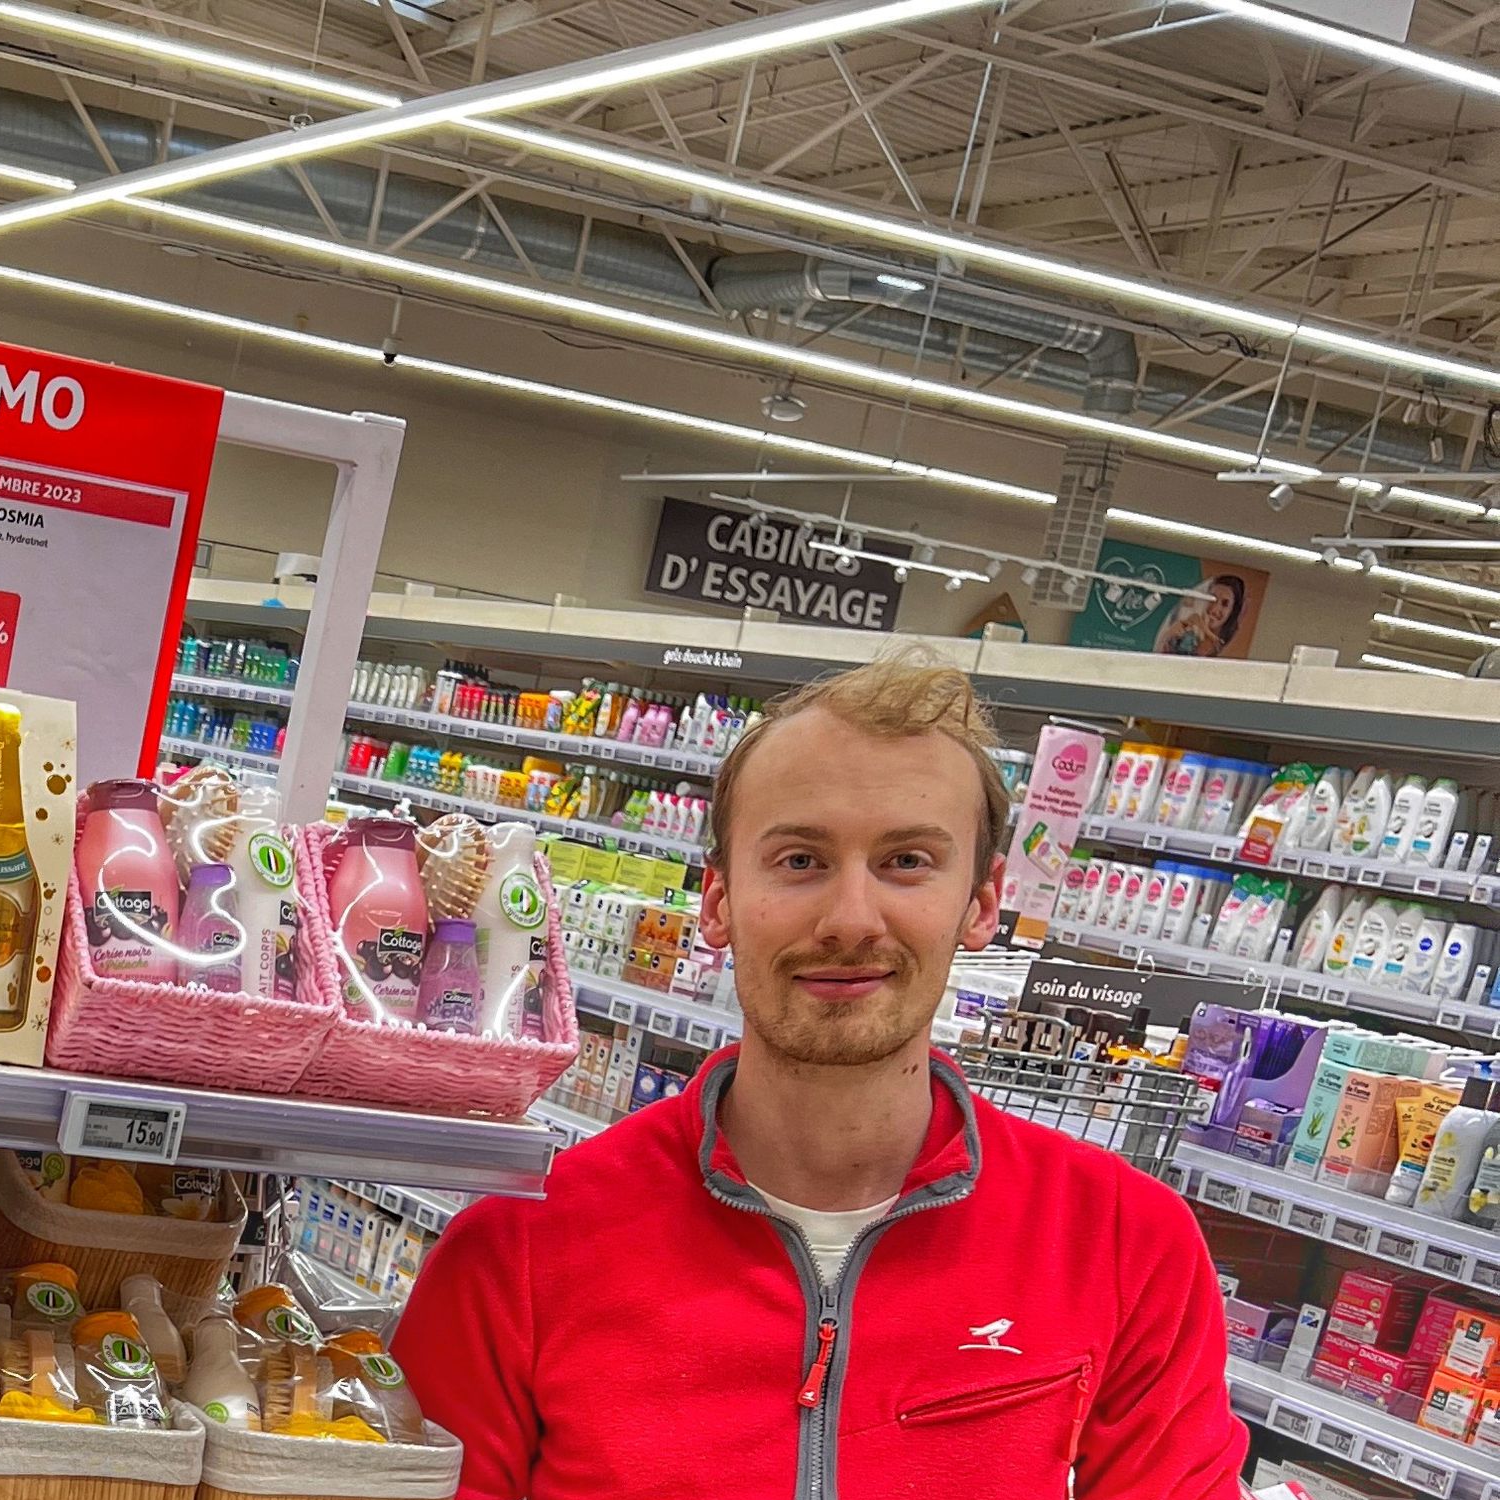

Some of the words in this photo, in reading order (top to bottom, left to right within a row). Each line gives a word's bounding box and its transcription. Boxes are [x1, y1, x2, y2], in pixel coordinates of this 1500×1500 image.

[42, 485, 82, 503] 2023
[702, 562, 887, 628] ESSAYAGE
[1032, 978, 1065, 996] soin
[1069, 982, 1088, 999] du
[1092, 984, 1142, 1007] visage
